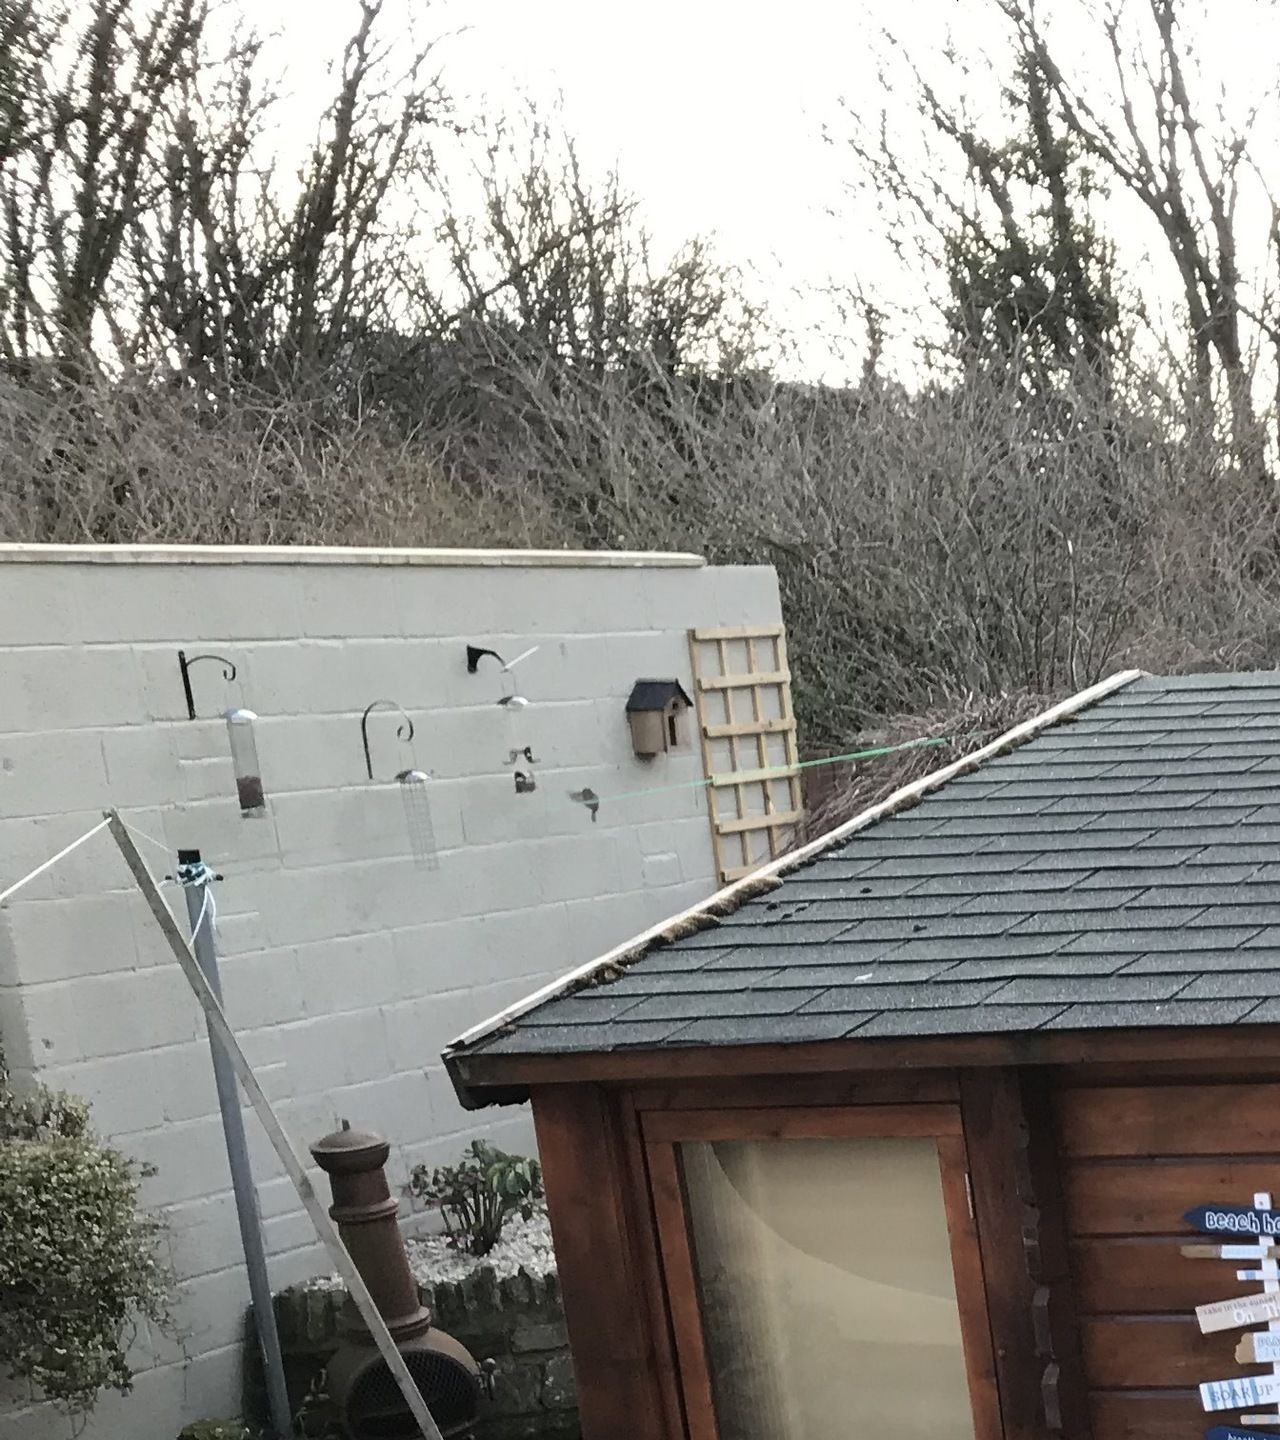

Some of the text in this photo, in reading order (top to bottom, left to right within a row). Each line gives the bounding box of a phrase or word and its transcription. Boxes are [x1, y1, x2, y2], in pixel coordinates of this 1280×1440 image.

[1205, 1211, 1260, 1233] Beach
[1212, 1387, 1251, 1402] SOAK
[1254, 1384, 1273, 1397] UP
